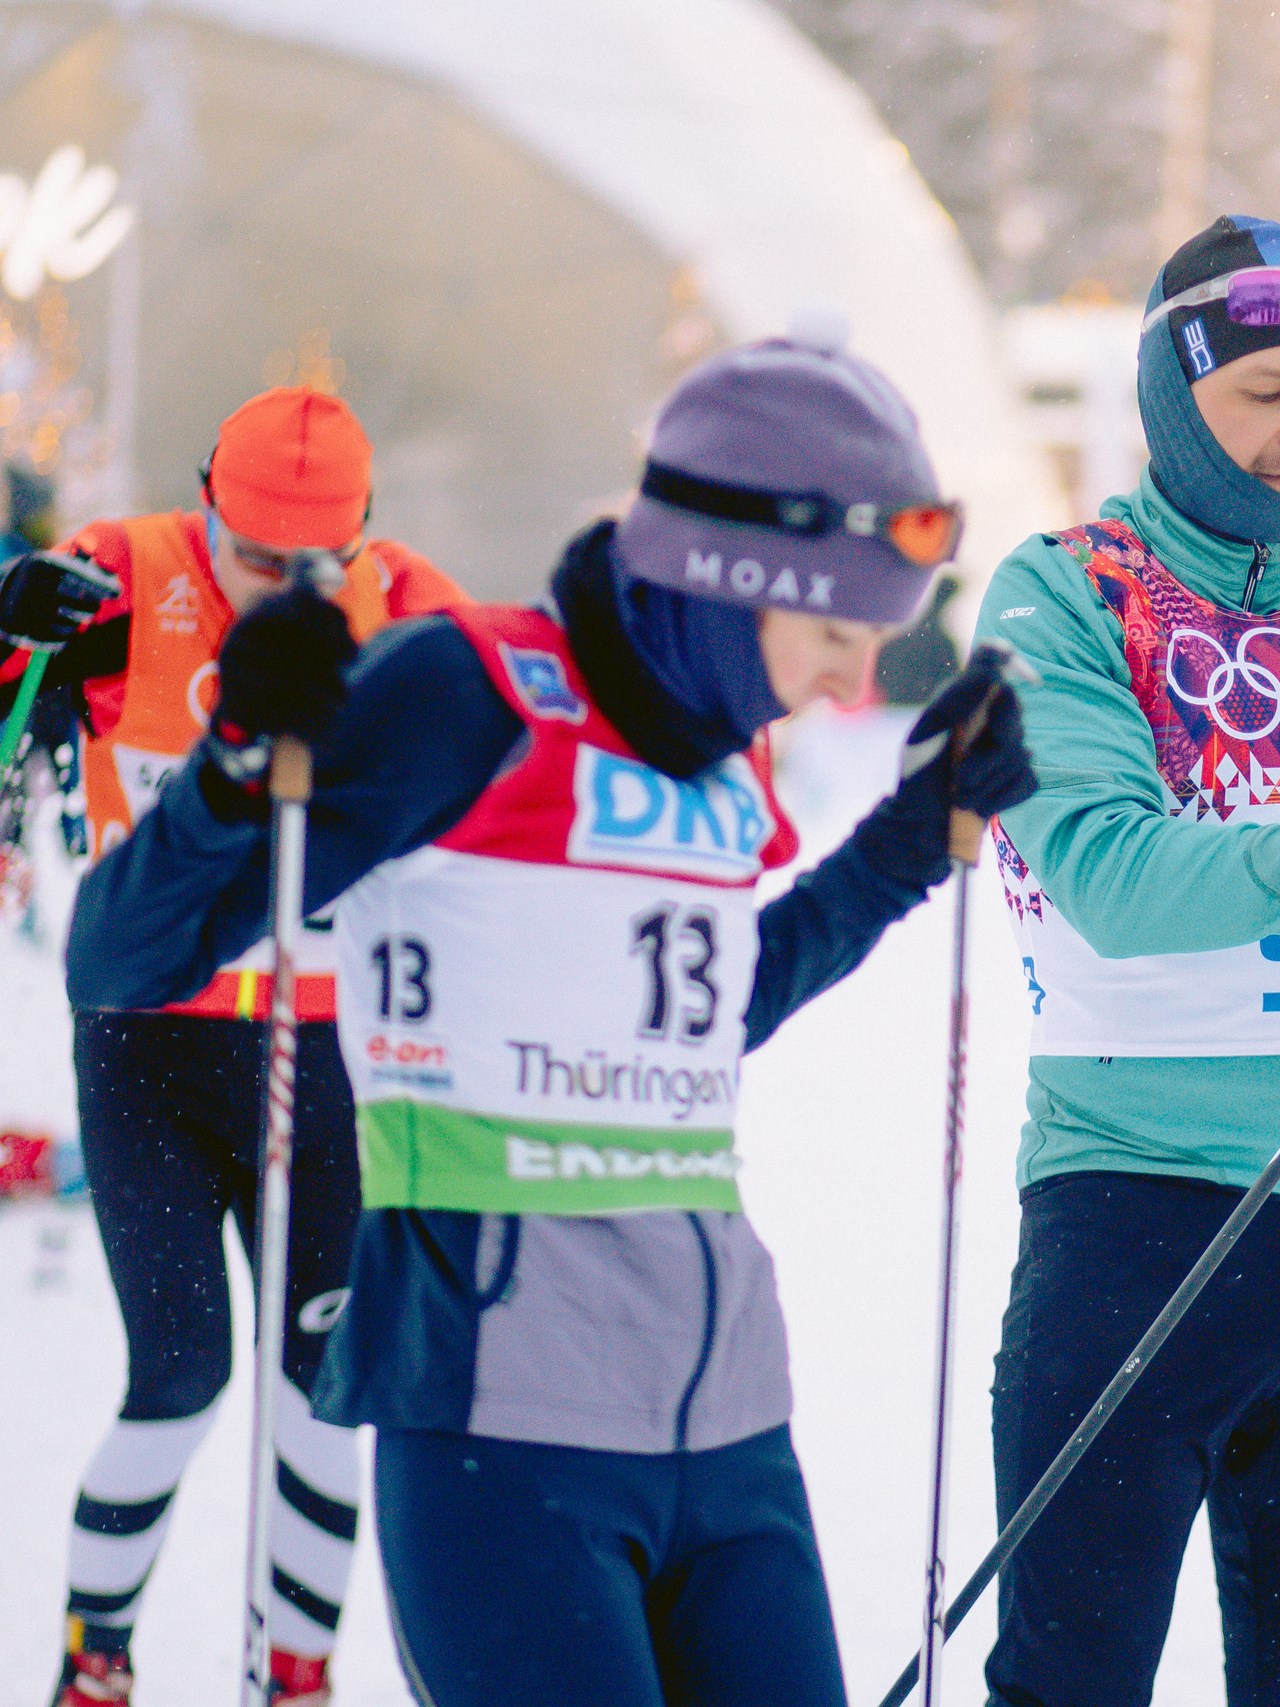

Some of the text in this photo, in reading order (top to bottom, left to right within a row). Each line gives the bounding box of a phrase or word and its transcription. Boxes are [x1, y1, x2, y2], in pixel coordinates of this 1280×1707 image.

[685, 550, 835, 607] MOAX
[593, 752, 763, 856] DKB
[369, 936, 433, 1022] 13
[632, 904, 719, 1044] 13
